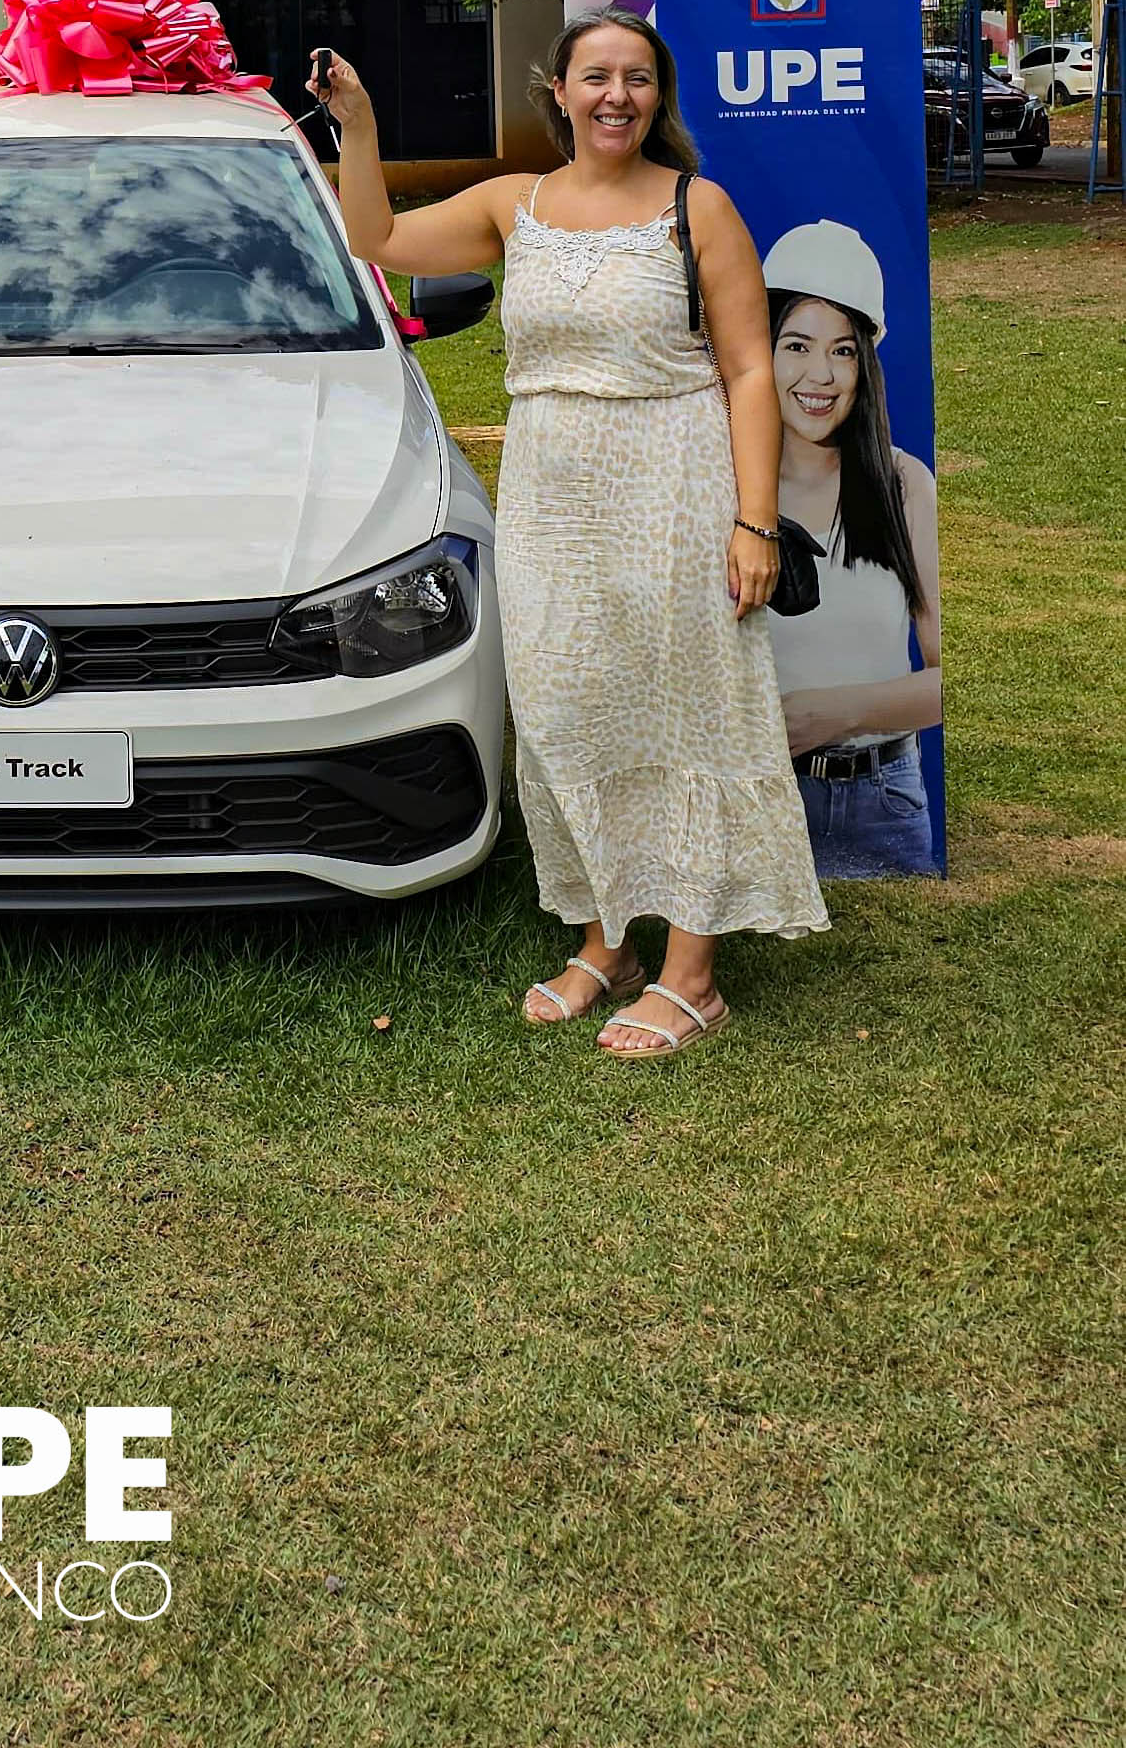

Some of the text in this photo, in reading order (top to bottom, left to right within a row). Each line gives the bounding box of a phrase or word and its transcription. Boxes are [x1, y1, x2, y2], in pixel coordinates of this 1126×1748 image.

[716, 47, 866, 105] UPE
[718, 110, 778, 118] UNIVERSIDAD
[781, 109, 819, 117] PRIVADA
[823, 108, 840, 116] DEL
[5, 758, 85, 778] Track
